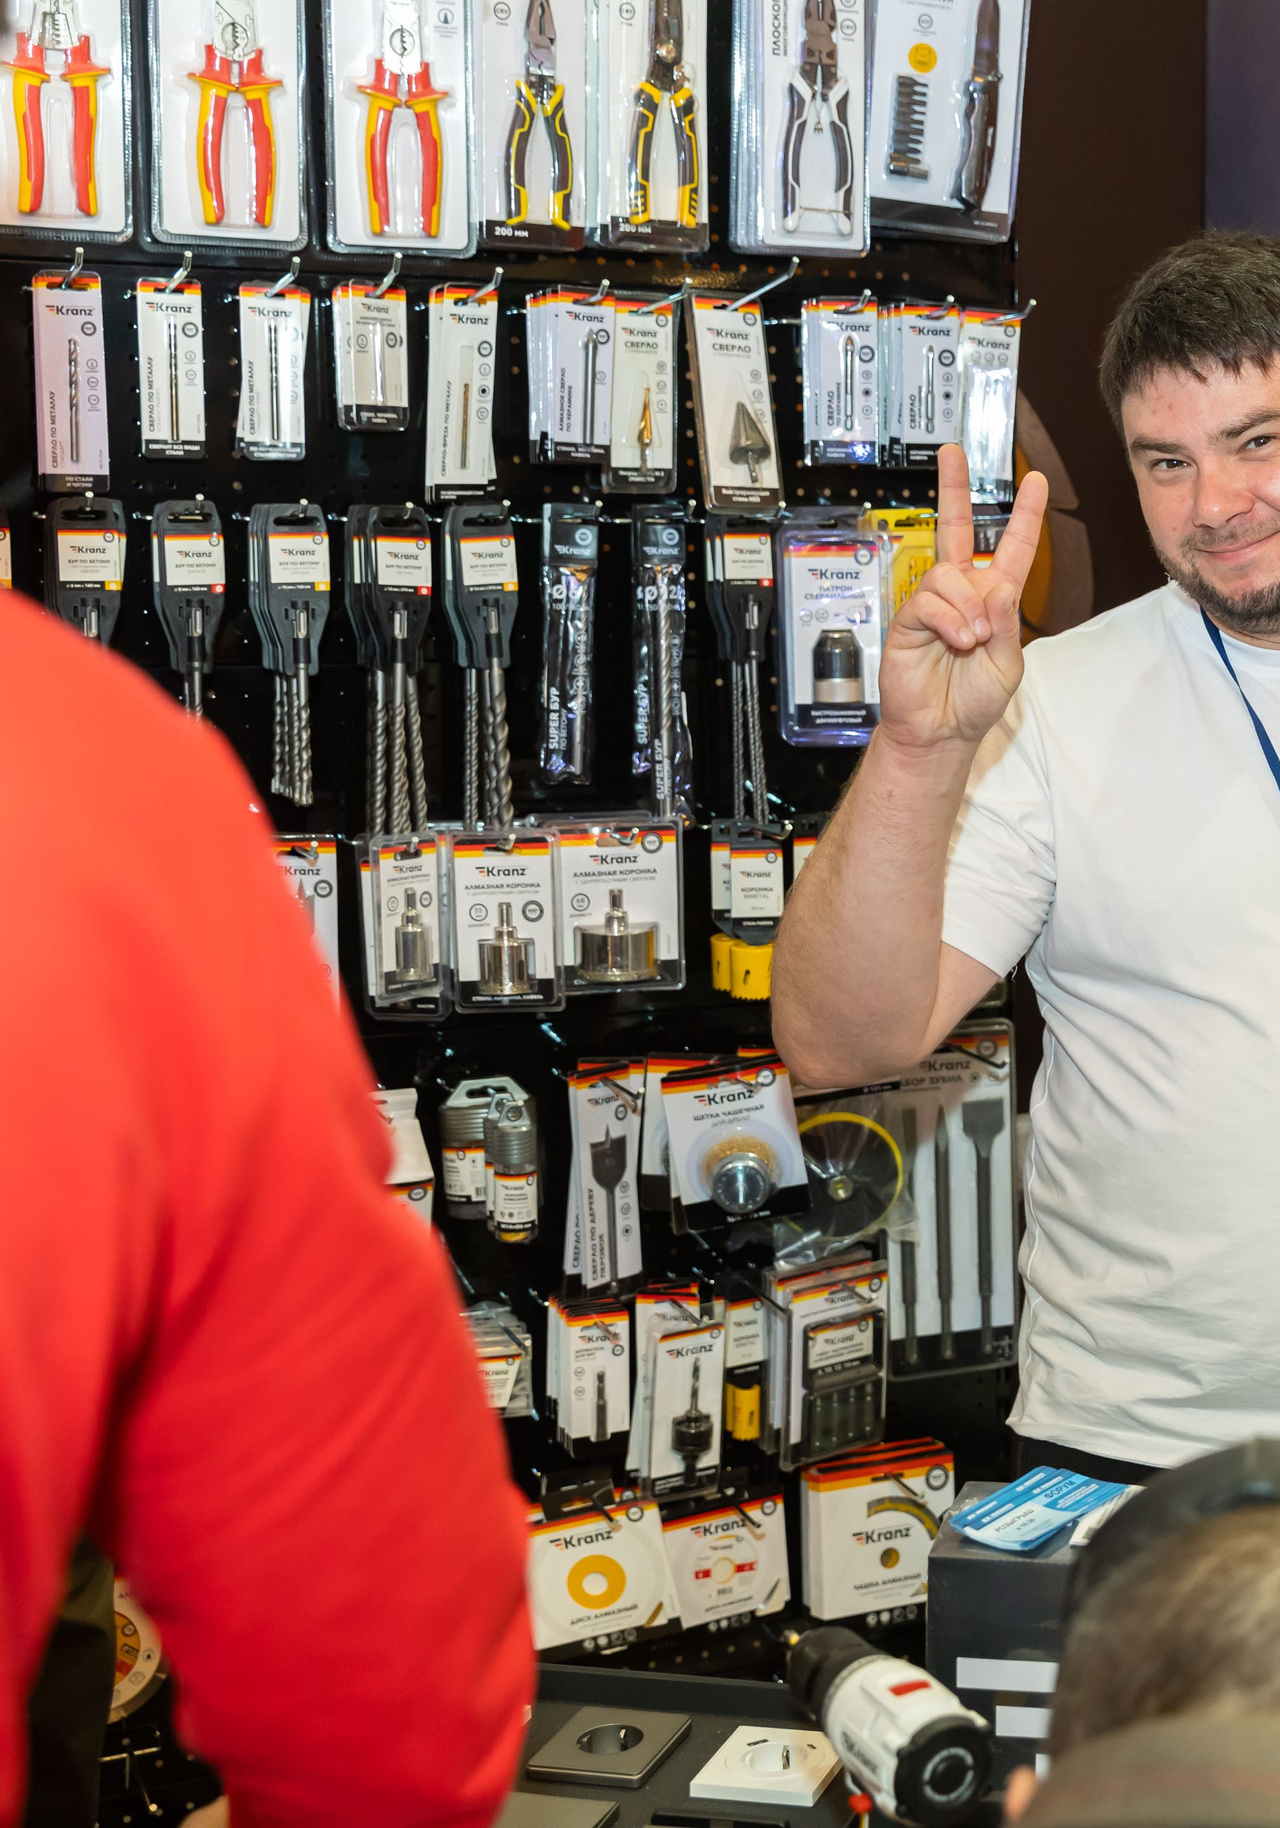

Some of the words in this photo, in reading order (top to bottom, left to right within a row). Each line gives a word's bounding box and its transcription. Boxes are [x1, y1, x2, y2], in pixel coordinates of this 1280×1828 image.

[495, 226, 513, 236] 200
[619, 223, 636, 233] 200
[56, 305, 93, 316] Kranz
[155, 302, 192, 314] Kranz
[258, 307, 292, 318] Kranz
[367, 303, 390, 314] Kranz
[458, 314, 489, 326] Kranz
[574, 312, 604, 323] Kranz
[629, 329, 657, 338] Kranz
[717, 329, 749, 341] Kranz
[918, 326, 951, 337] Kranz
[625, 341, 658, 350] СВЕРЛО
[713, 343, 752, 353] СВЕРЛО
[977, 338, 1011, 350] Kranz
[147, 357, 155, 390] МЕТАЛЛУ
[149, 392, 155, 403] ПО
[248, 395, 255, 405] ПО
[49, 391, 57, 425] МЕТАЛЛУ
[826, 391, 835, 426] СВЕРЛО
[909, 394, 917, 429] СВЕРЛО
[51, 427, 57, 439] ПО
[78, 546, 106, 554] Kranz
[289, 548, 316, 556] Kranz
[478, 551, 504, 559] Kranz
[562, 547, 591, 556] Kranz
[650, 547, 679, 556] Kranz
[393, 553, 419, 561] Kranz
[820, 569, 861, 580] Kranz
[549, 687, 560, 710] БУР
[548, 712, 559, 750] SUPER
[637, 709, 648, 745] SUPER
[654, 739, 663, 762] БУР
[655, 764, 665, 800] SUPER
[600, 855, 638, 865] Kranz
[285, 867, 321, 876] Kranz
[400, 864, 423, 874] Kranz
[487, 866, 526, 877] Kranz
[573, 870, 618, 878] АЛМАЗНАЯ
[619, 868, 658, 876] КОРОНКА
[928, 1060, 971, 1072] Kranz
[708, 1090, 754, 1106] Kranz
[693, 1111, 720, 1122] ЩЕТКА
[722, 1104, 765, 1118] ЧАШЕЧНАЯ
[676, 1345, 713, 1358] Kranz
[1044, 1480, 1078, 1499] ФОРУМ
[994, 1508, 1035, 1532] РОЗЫГРЫШ
[703, 1518, 747, 1537] Kranz
[564, 1530, 613, 1549] Kranz
[866, 1526, 912, 1545] Kranz
